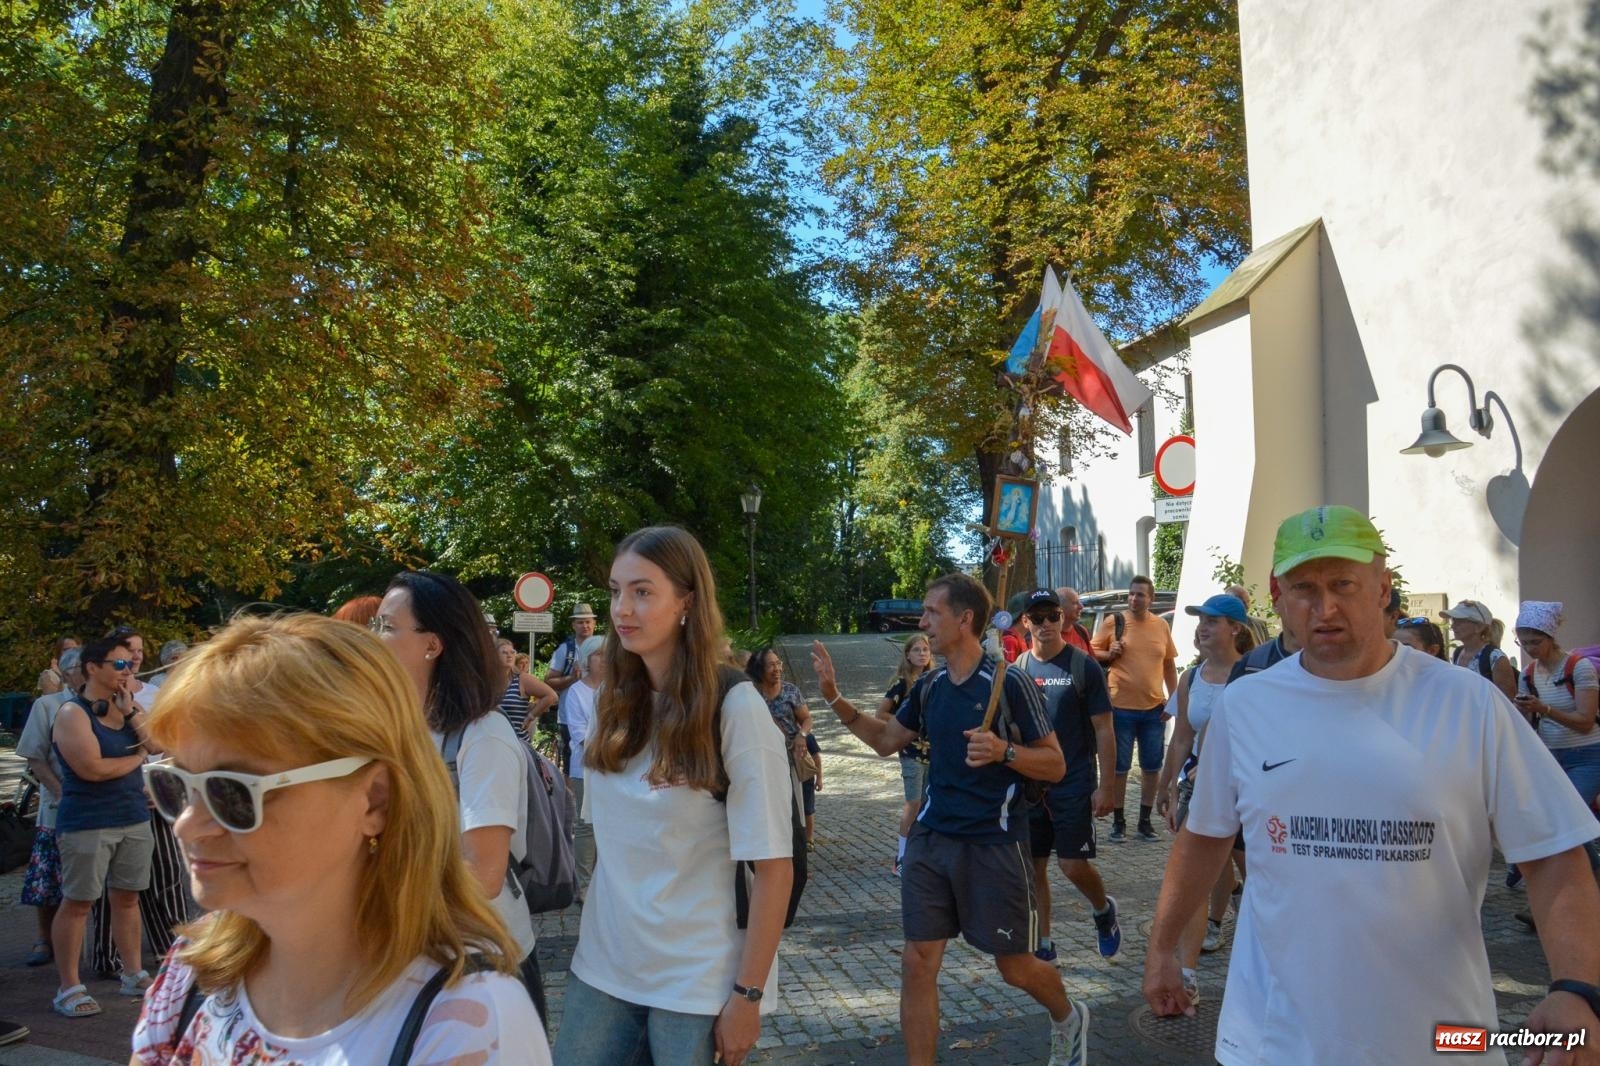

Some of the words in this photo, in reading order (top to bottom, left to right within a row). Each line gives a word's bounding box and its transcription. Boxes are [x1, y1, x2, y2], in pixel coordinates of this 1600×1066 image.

[1042, 678, 1072, 686] JONES
[1290, 815, 1329, 842] AKADEMIA
[1331, 818, 1379, 845] PIŁKARSKA
[1380, 820, 1436, 846] GRASSROOTS
[1292, 843, 1312, 856] TEST
[1313, 845, 1373, 861] SPRAWNOŚCI
[1375, 848, 1432, 862] PIŁKARSKIEJ
